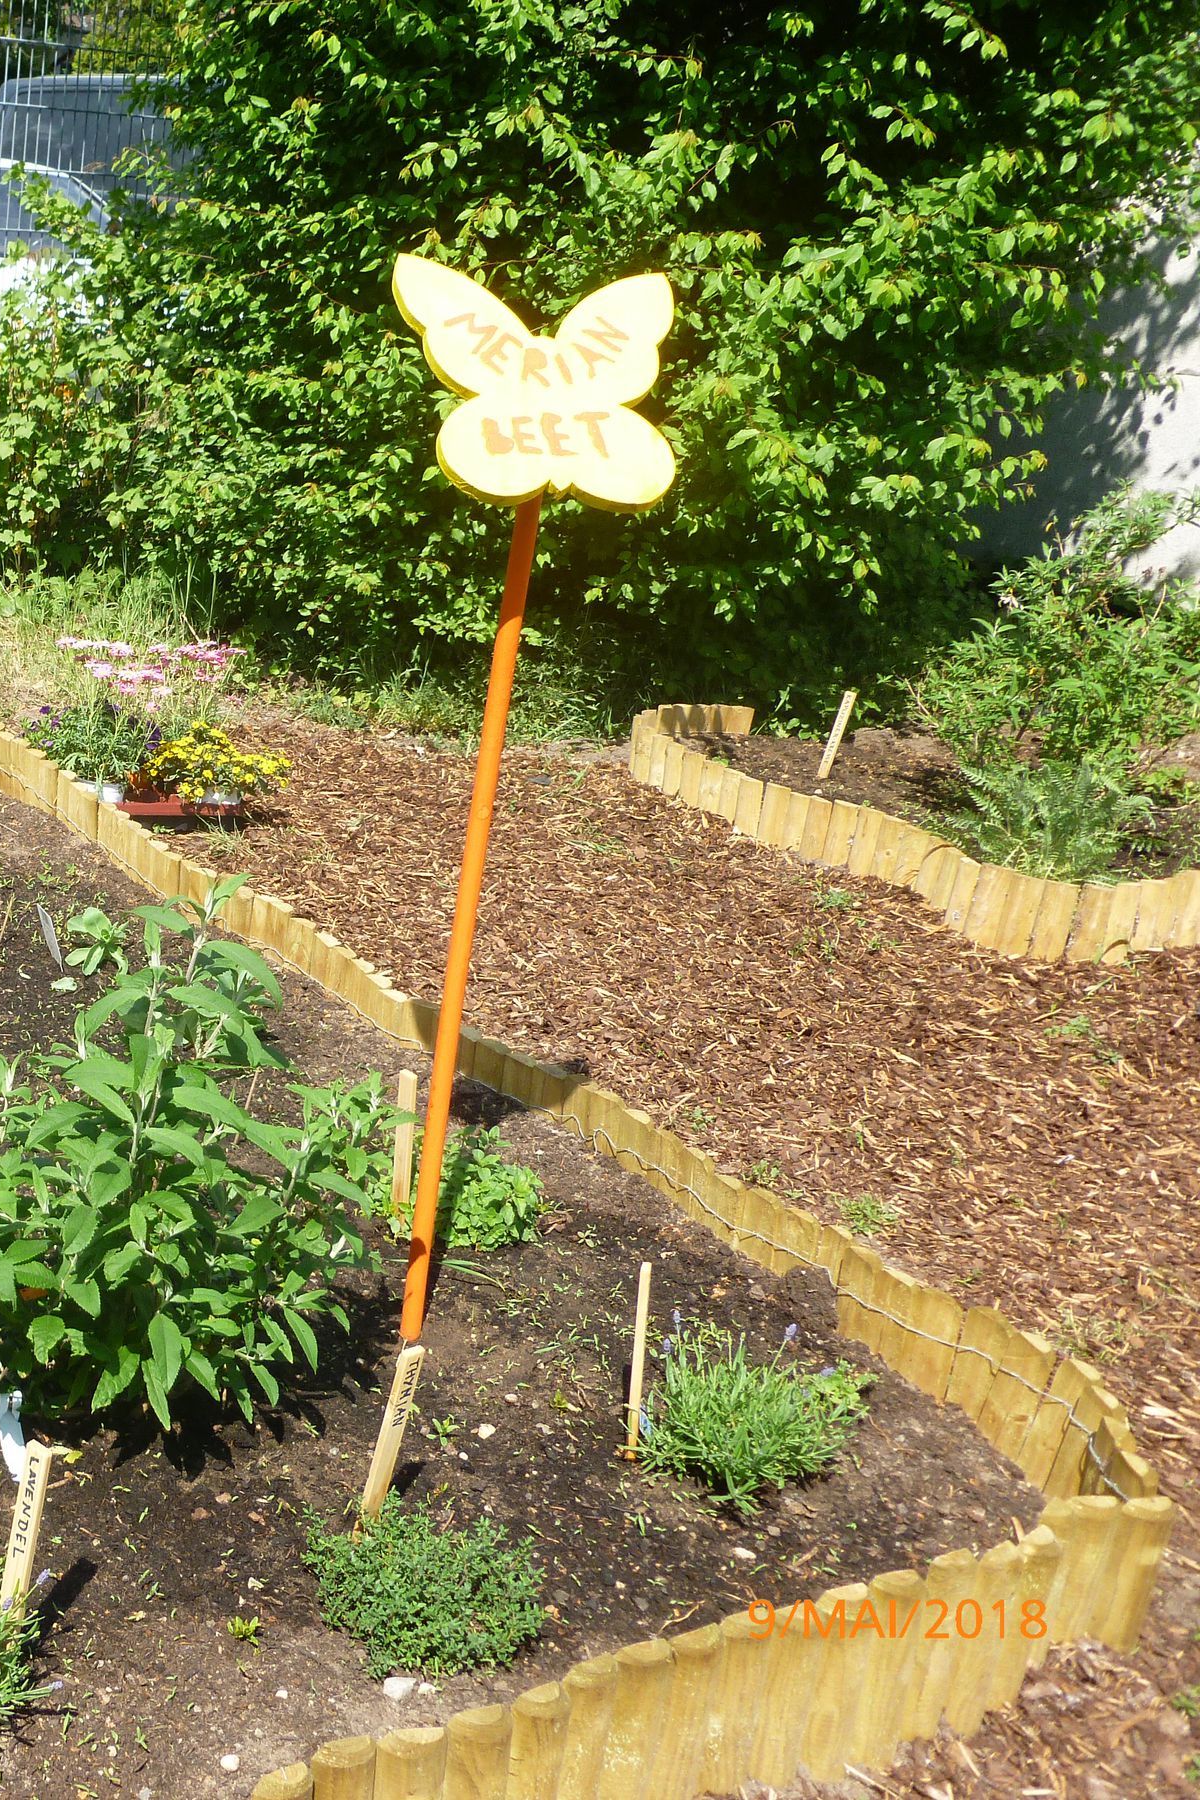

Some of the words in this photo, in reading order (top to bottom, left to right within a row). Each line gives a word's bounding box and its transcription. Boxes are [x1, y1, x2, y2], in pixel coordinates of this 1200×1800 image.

[444, 313, 630, 387] MERIAN
[481, 411, 610, 459] BEET
[391, 1356, 421, 1428] THYMIAN
[12, 1456, 40, 1559] LAVENDEL
